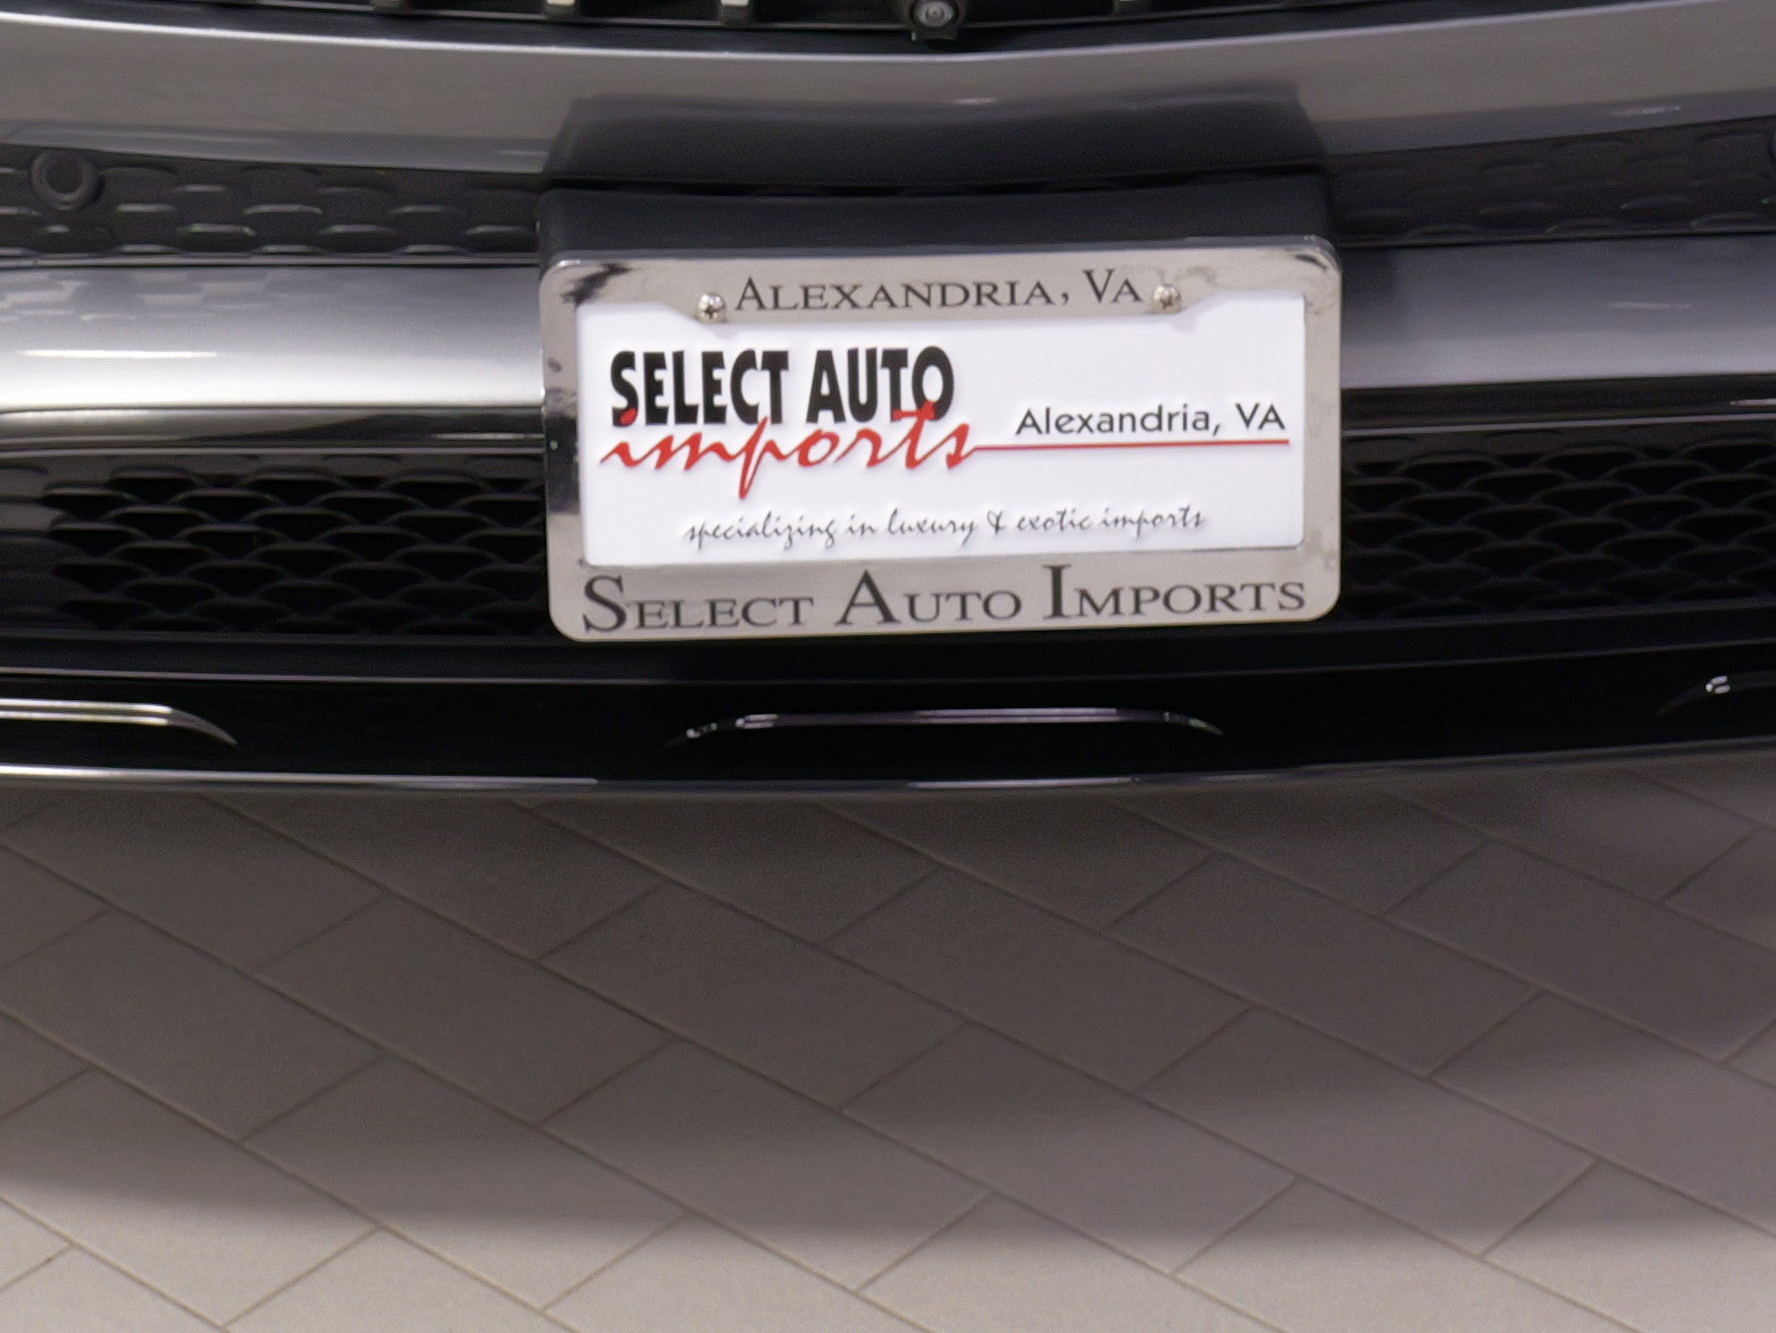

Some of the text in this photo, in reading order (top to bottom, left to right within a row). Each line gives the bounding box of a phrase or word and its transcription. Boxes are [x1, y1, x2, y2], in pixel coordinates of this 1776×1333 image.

[734, 275, 1070, 312] ALEXANDRIA,
[610, 345, 955, 428] SELECT AUTO
[1014, 401, 1287, 437] Alexandria, VA
[600, 400, 976, 500] imports
[684, 503, 1207, 551] specializing in luxury & exotic imports
